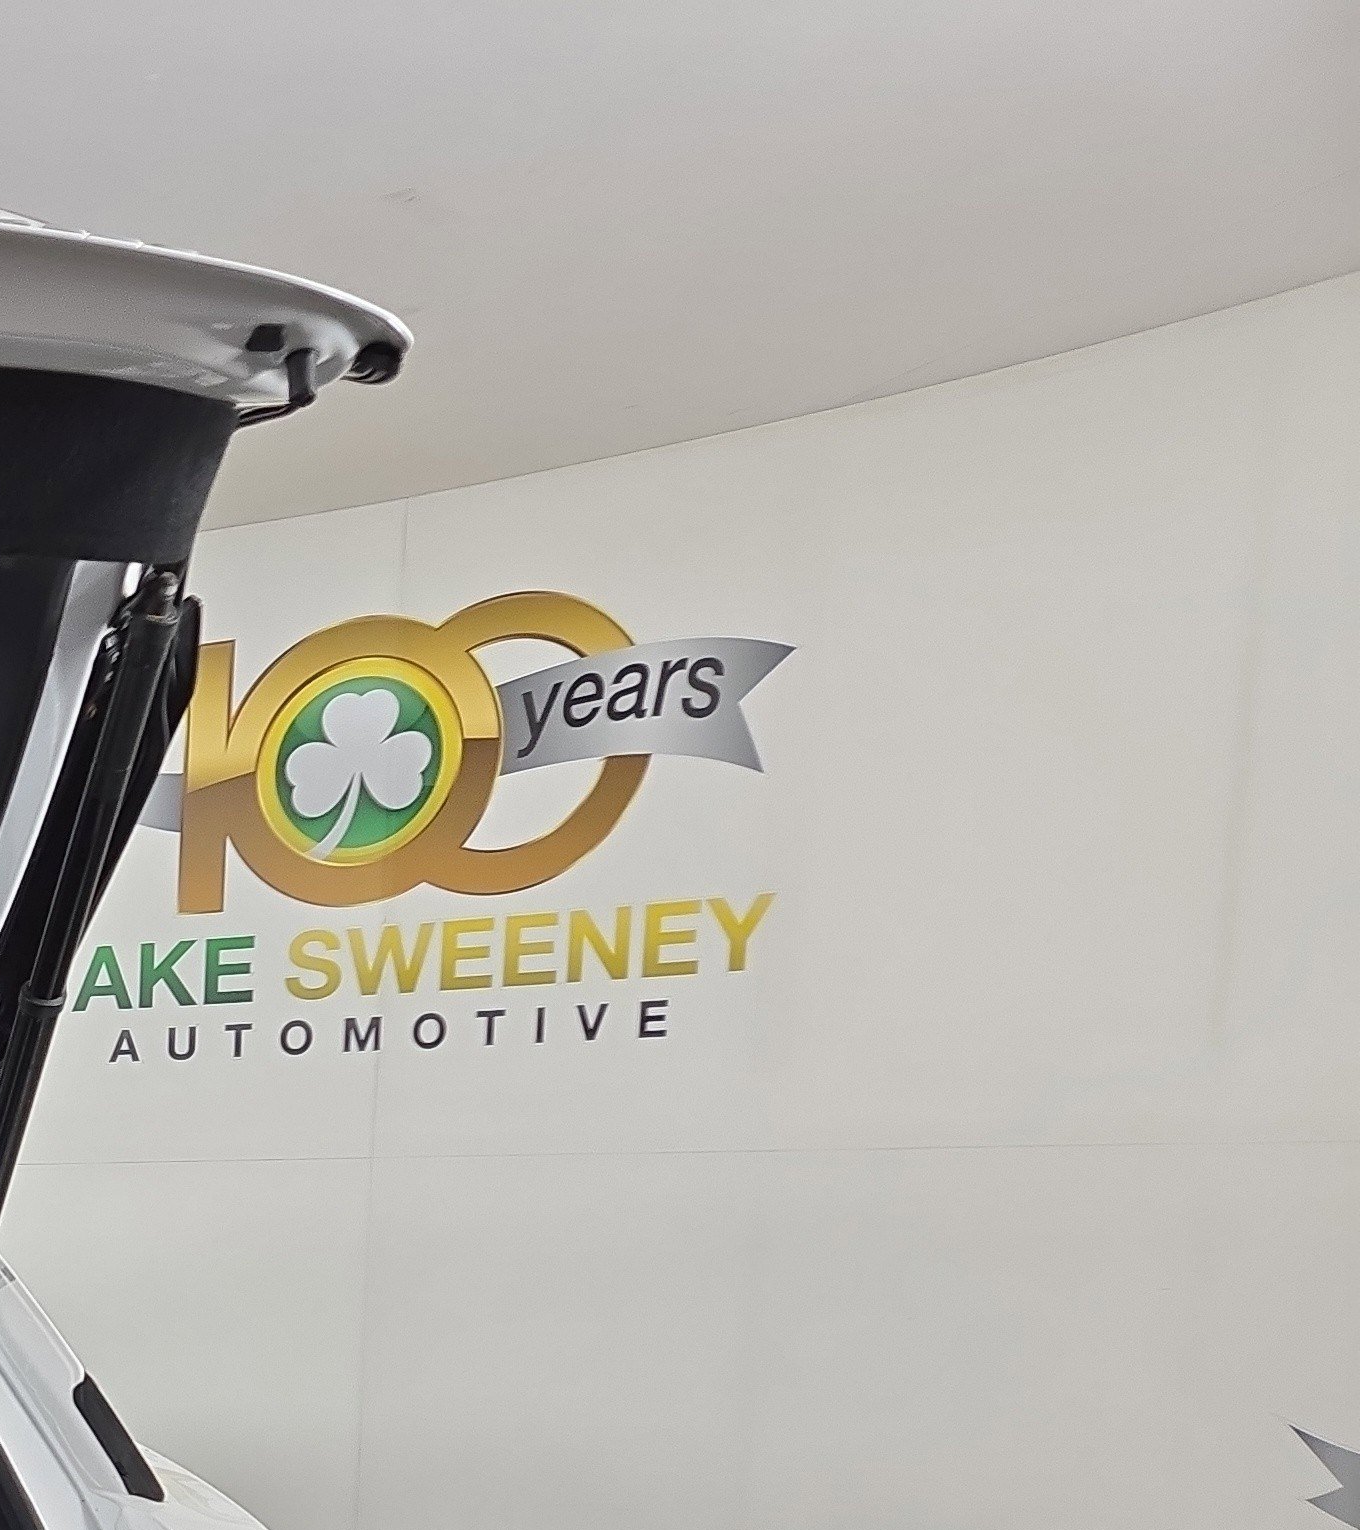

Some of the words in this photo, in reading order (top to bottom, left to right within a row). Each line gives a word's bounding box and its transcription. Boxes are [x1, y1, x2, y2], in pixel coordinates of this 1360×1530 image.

[176, 589, 652, 914] 100
[516, 655, 727, 757] years
[71, 935, 257, 1012] AKE
[284, 892, 778, 1001] SWEENEY
[107, 1000, 671, 1064] AUTOMOTIVE
